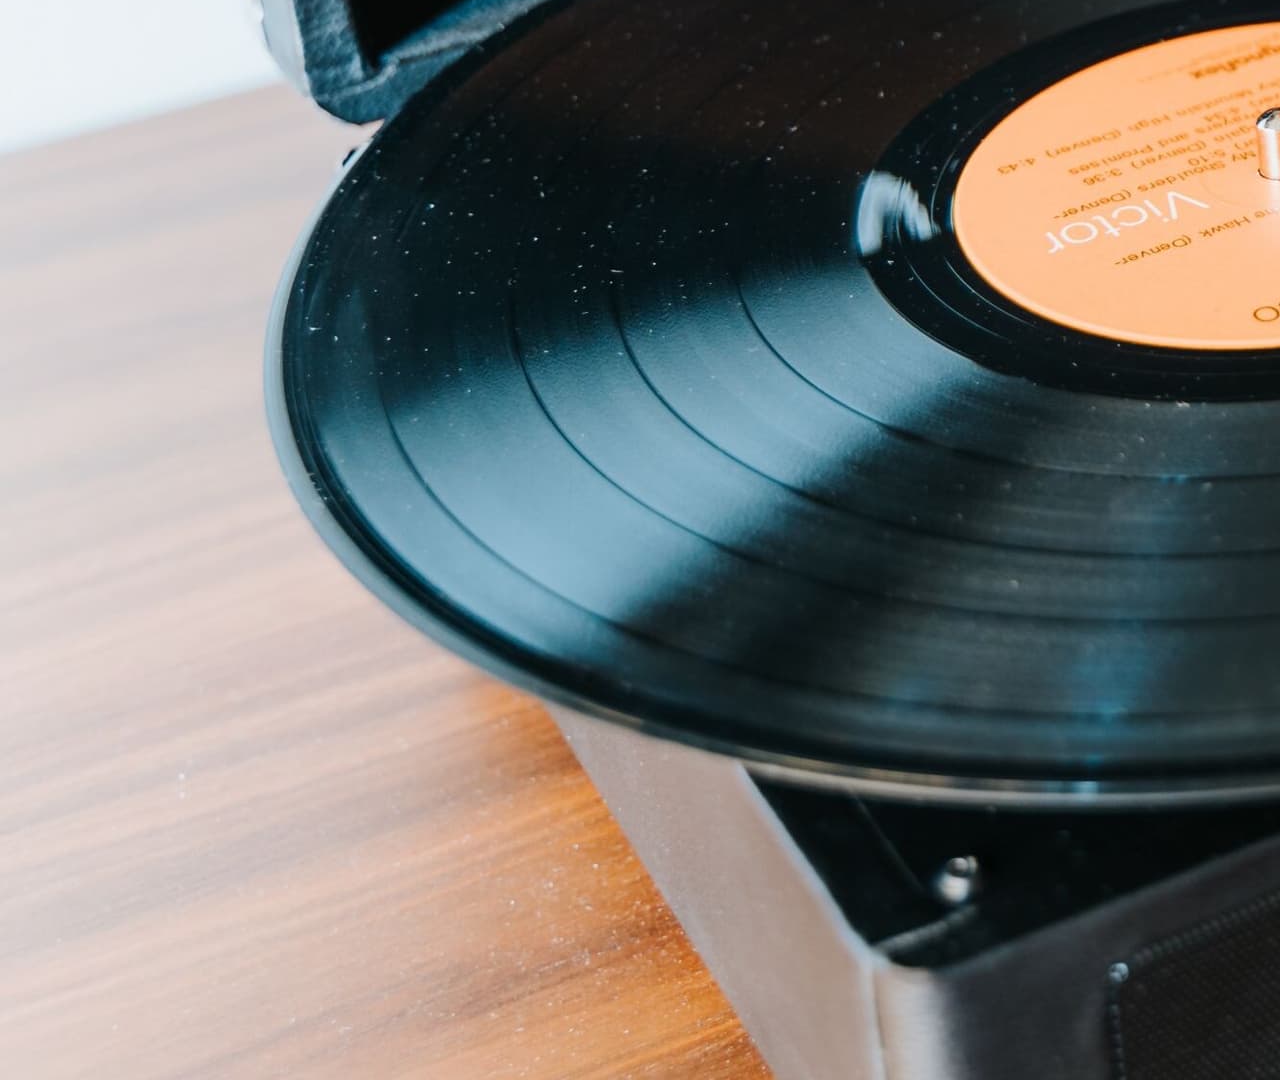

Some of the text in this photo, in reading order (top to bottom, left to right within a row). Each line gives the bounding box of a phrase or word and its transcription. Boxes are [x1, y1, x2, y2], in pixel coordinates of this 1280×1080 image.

[1157, 133, 1190, 147] and
[1212, 125, 1257, 143] gain
[1229, 150, 1256, 163] My
[1136, 161, 1225, 193] Shoulders
[1050, 189, 1133, 221] (Denver-
[1047, 192, 1207, 252] Victor
[1198, 216, 1251, 238] Hawk
[1111, 235, 1194, 267] (Denver-
